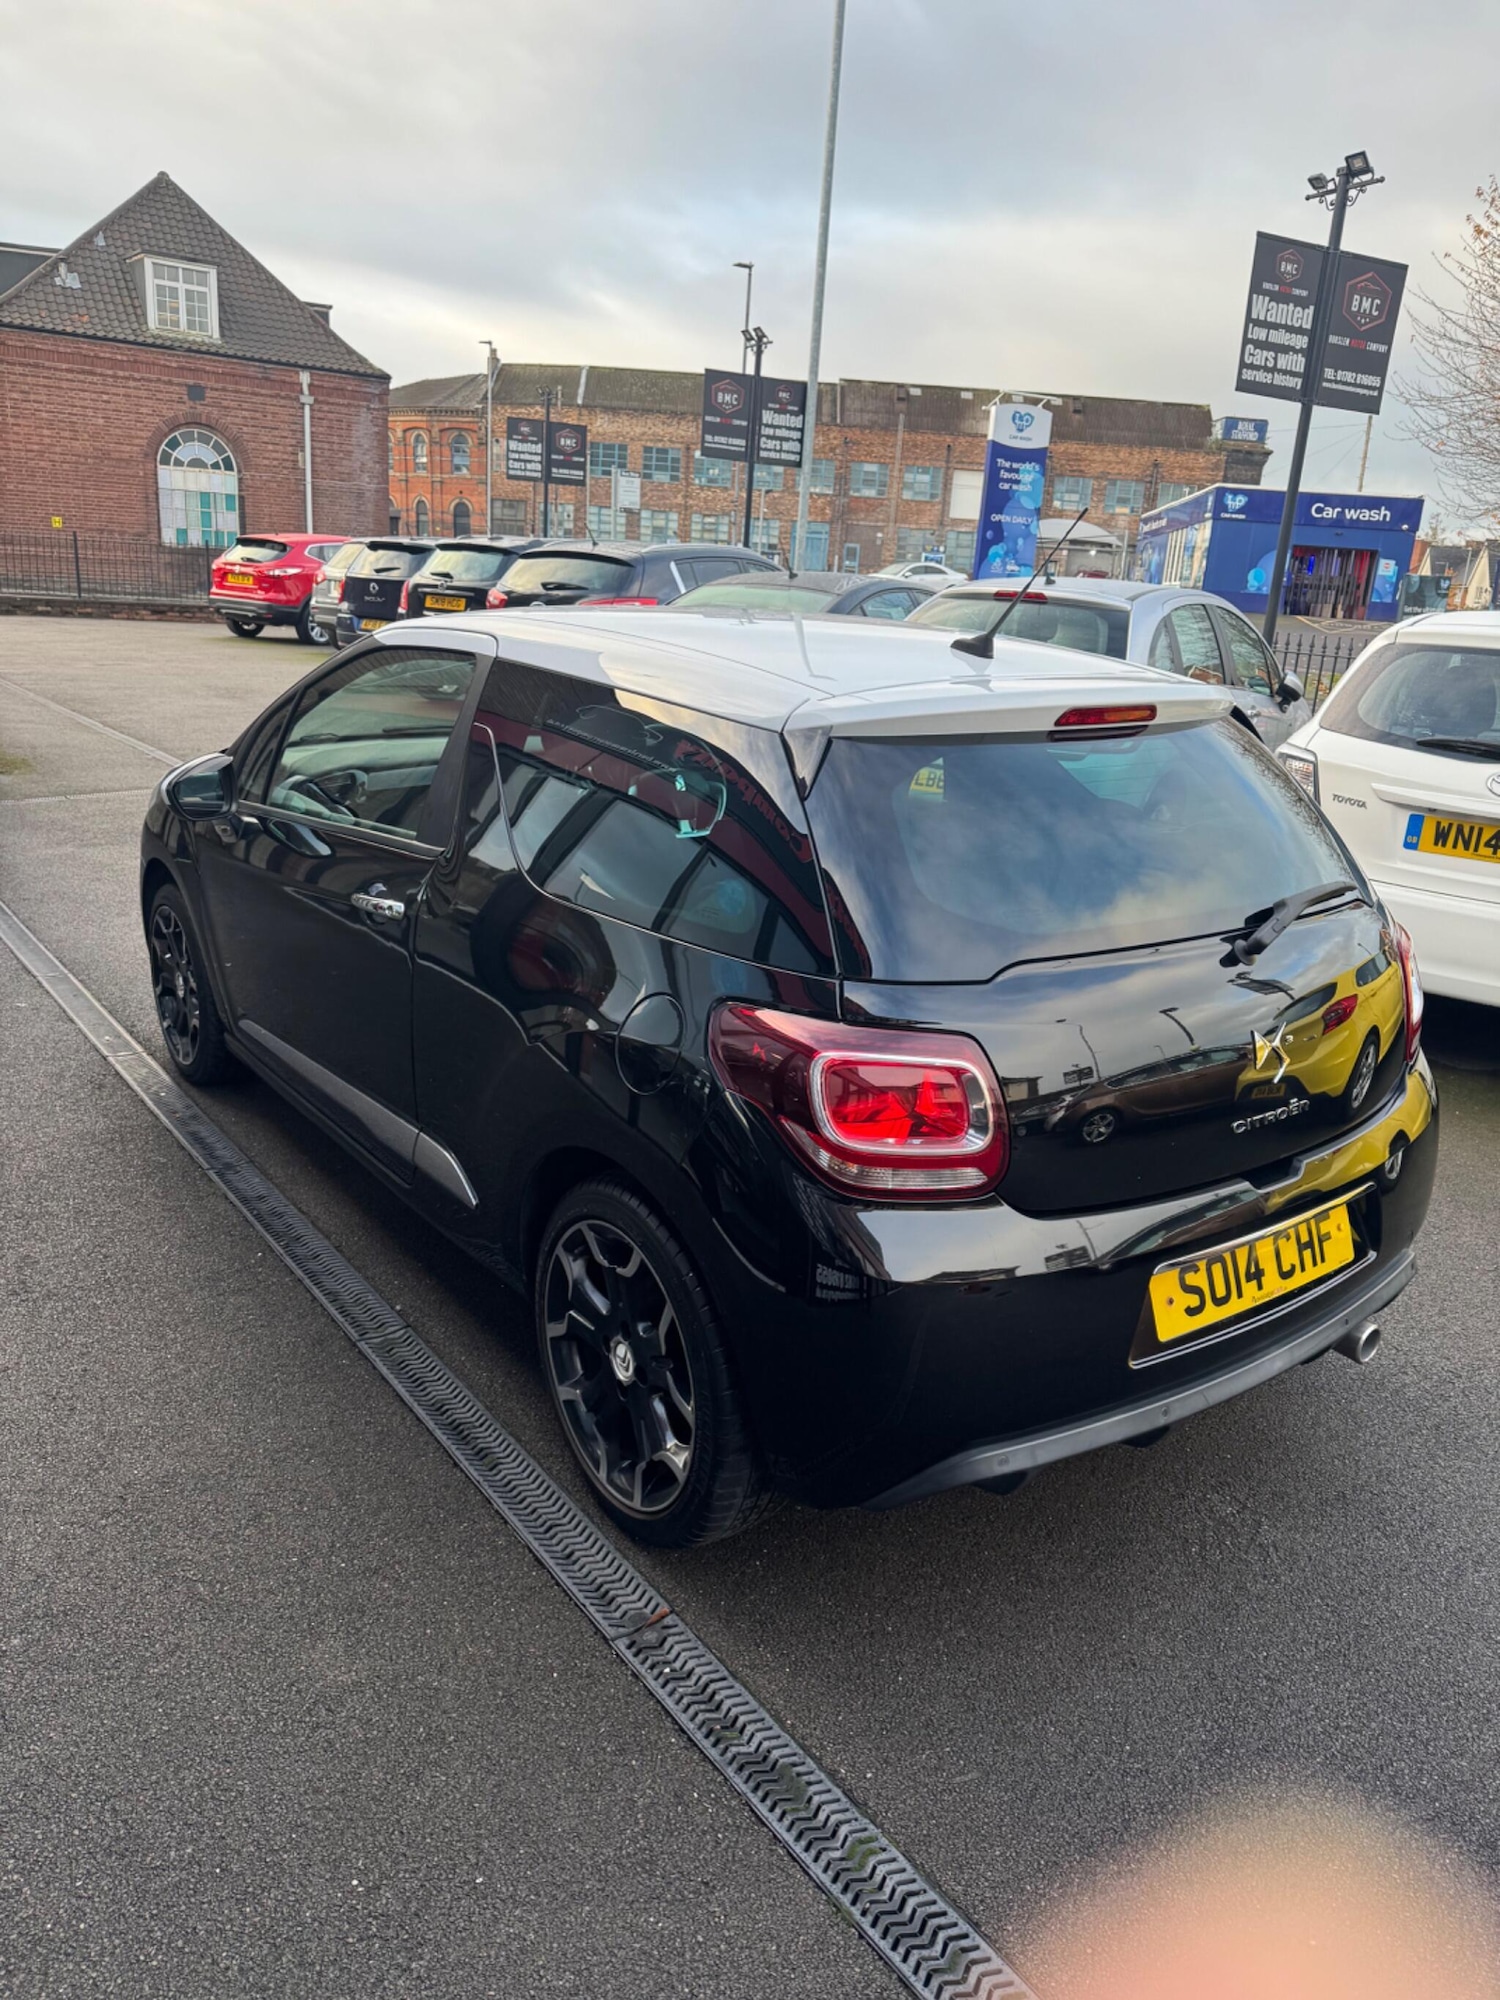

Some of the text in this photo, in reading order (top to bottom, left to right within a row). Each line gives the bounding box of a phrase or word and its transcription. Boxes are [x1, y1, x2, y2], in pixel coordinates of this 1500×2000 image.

[1280, 261, 1298, 274] BMC
[1251, 293, 1315, 330] Wanted
[1351, 294, 1381, 316] BMC
[1248, 323, 1309, 349] Low mileage
[1244, 344, 1306, 373] Cars with
[1241, 367, 1273, 384] service
[1273, 371, 1303, 390] history
[717, 391, 738, 405] BMC
[762, 409, 803, 429] Wanted
[508, 440, 542, 454] Wanted
[760, 437, 781, 450] Cars
[996, 458, 1040, 472] The world's
[998, 482, 1033, 492] car wash
[990, 513, 1033, 525] OPEN DAILY
[1311, 502, 1391, 522] Car wash
[1332, 793, 1367, 810] TOYOTA
[1433, 820, 1500, 856] WN14
[1231, 1097, 1310, 1134] CITROËN
[1178, 1211, 1332, 1317] SO14 CHF
